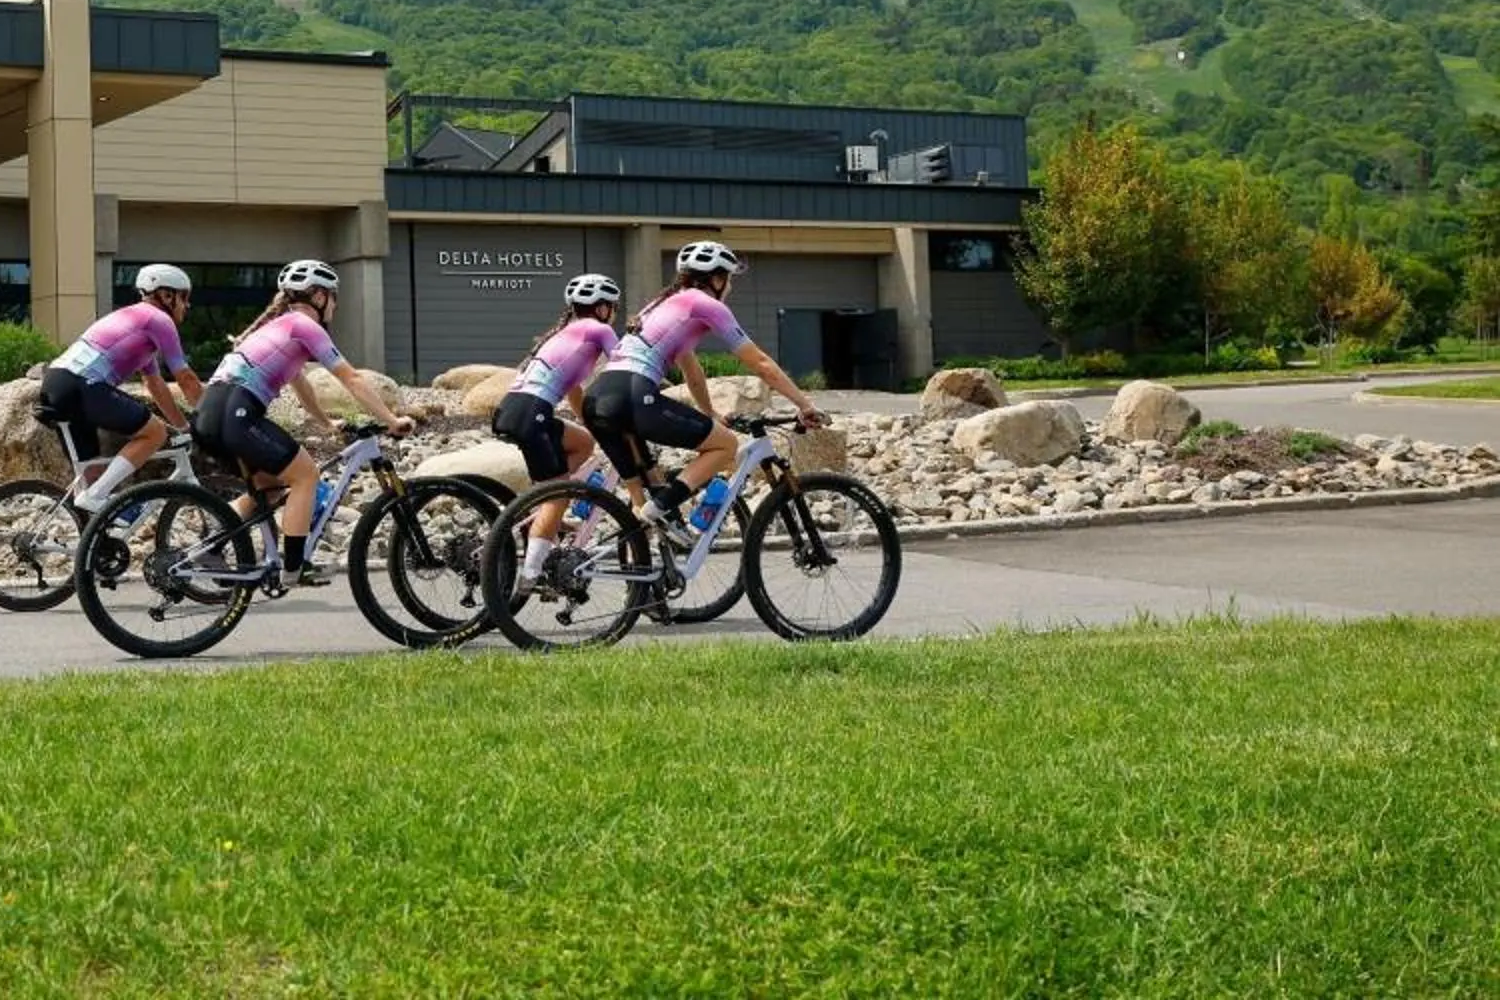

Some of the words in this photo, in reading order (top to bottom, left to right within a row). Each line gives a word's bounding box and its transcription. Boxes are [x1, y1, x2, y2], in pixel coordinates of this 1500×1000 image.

[438, 251, 491, 266] DELTA
[498, 252, 564, 268] HOTELS
[471, 279, 533, 289] MARRIOTT
